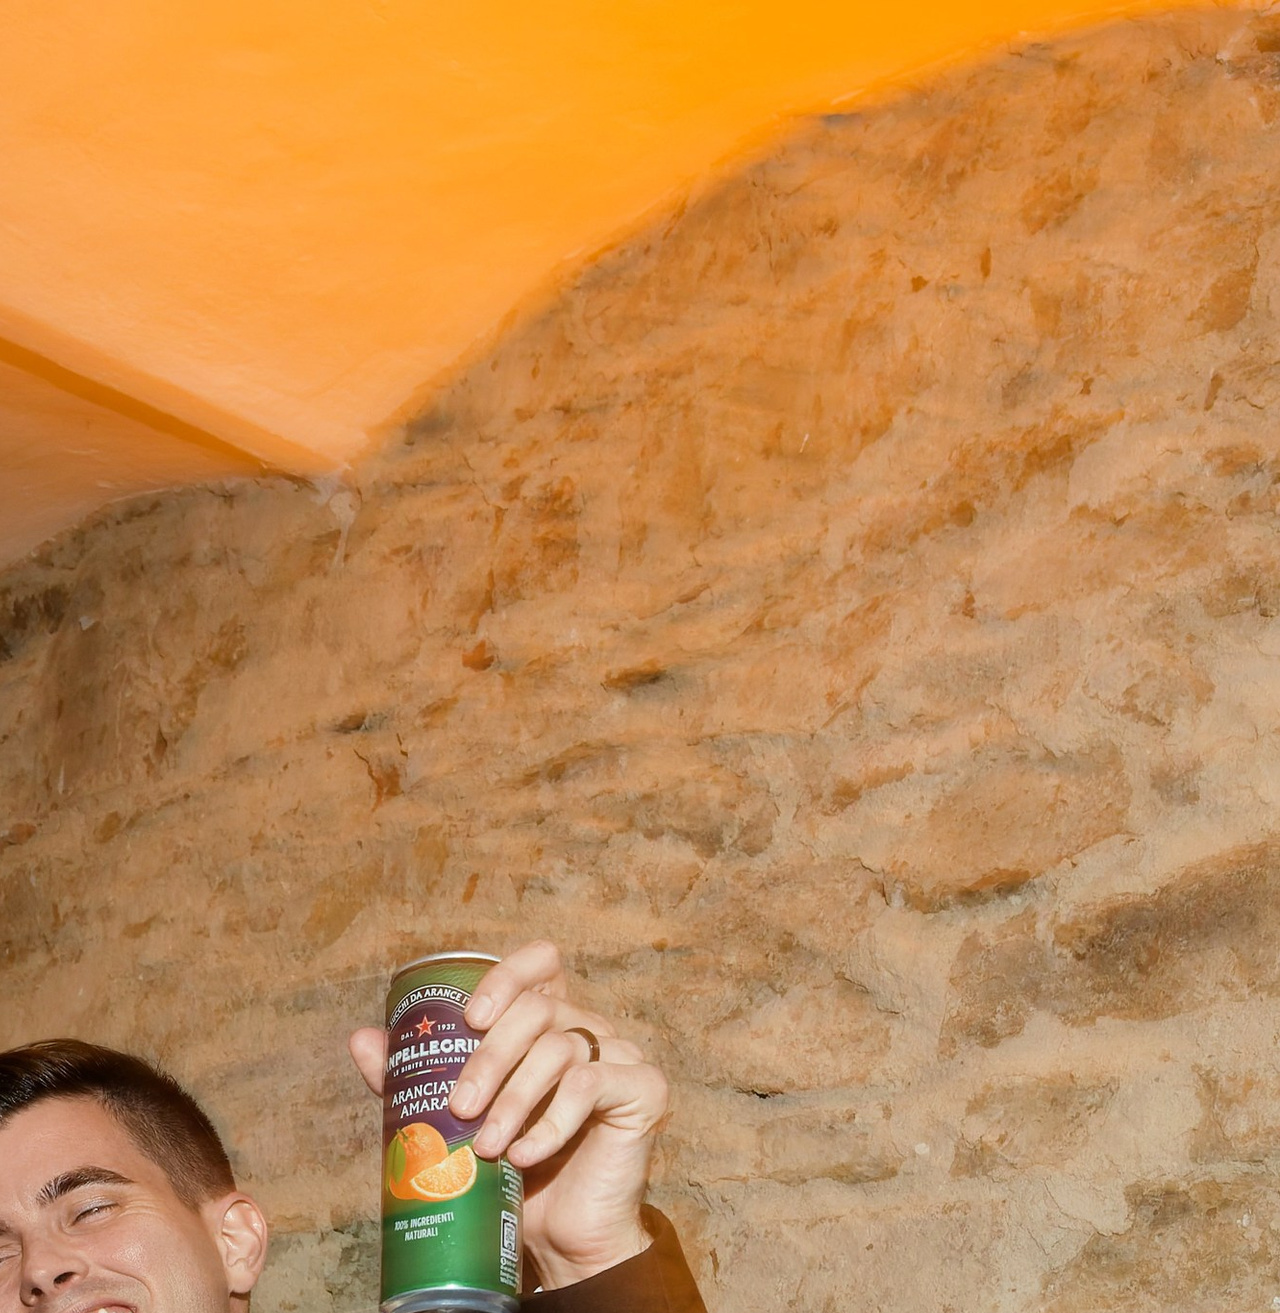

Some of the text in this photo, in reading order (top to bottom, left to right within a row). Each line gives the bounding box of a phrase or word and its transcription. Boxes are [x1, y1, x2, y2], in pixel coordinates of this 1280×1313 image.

[410, 991, 422, 1003] DA
[424, 988, 462, 1002] ARANCE
[400, 1023, 456, 1041] DAL 1932
[401, 1060, 423, 1074] BIBITE
[426, 1056, 466, 1067] ITALIANE
[400, 1096, 449, 1119] AMARA
[394, 1211, 455, 1231] 100% INGREDIENTI
[404, 1226, 439, 1241] NATURALI
